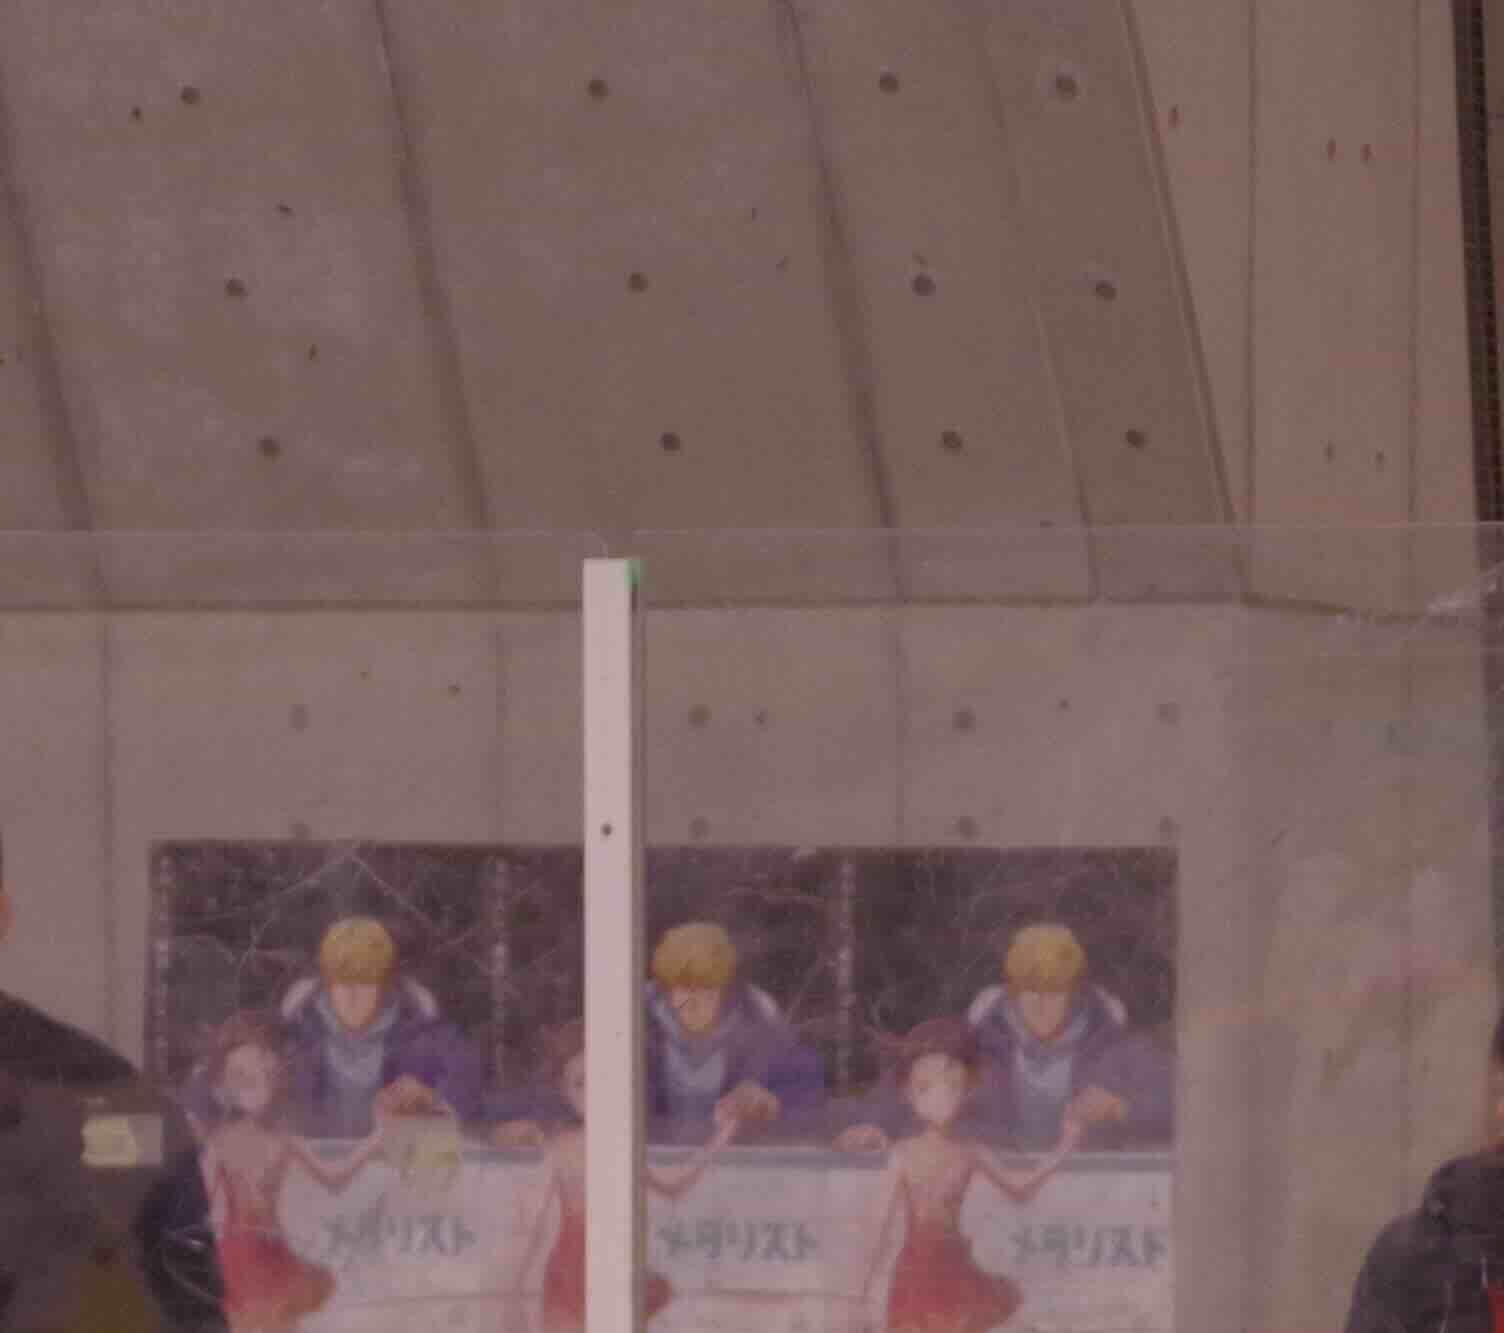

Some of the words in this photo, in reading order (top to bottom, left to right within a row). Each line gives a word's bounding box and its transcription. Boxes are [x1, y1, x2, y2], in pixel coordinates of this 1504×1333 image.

[655, 1219, 819, 1260] メダリスト
[1007, 1223, 1167, 1267] メダリスト
